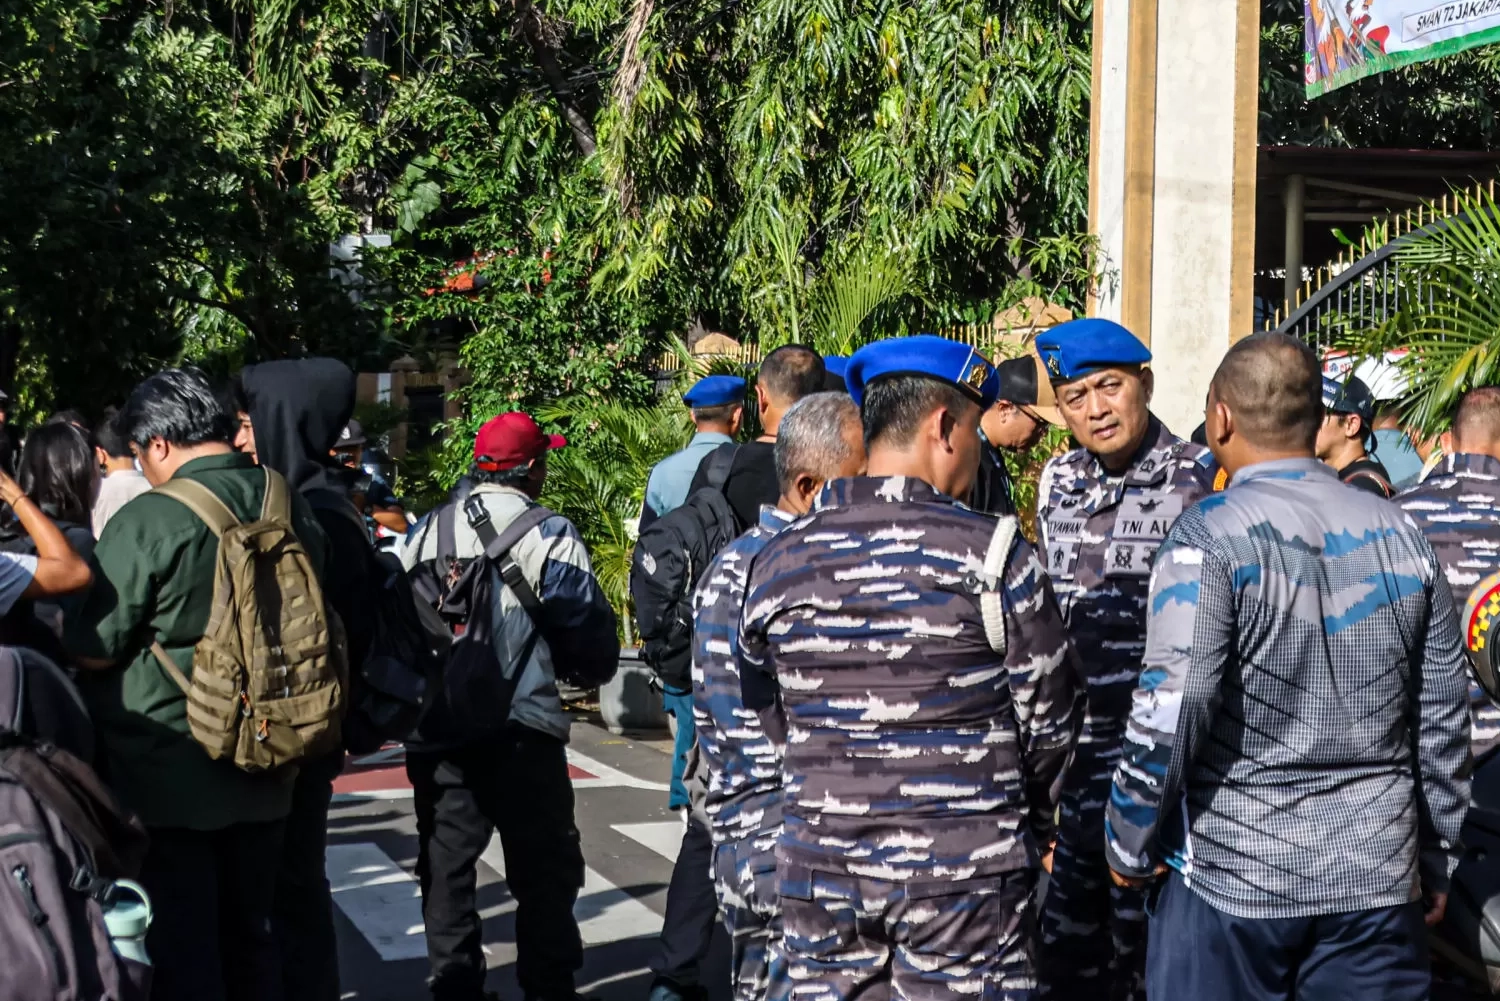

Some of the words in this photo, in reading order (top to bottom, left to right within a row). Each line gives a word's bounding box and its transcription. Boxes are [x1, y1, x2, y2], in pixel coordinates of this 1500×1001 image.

[1416, 10, 1442, 31] SMAN
[1443, 6, 1454, 23] 72
[1122, 521, 1143, 534] TNI
